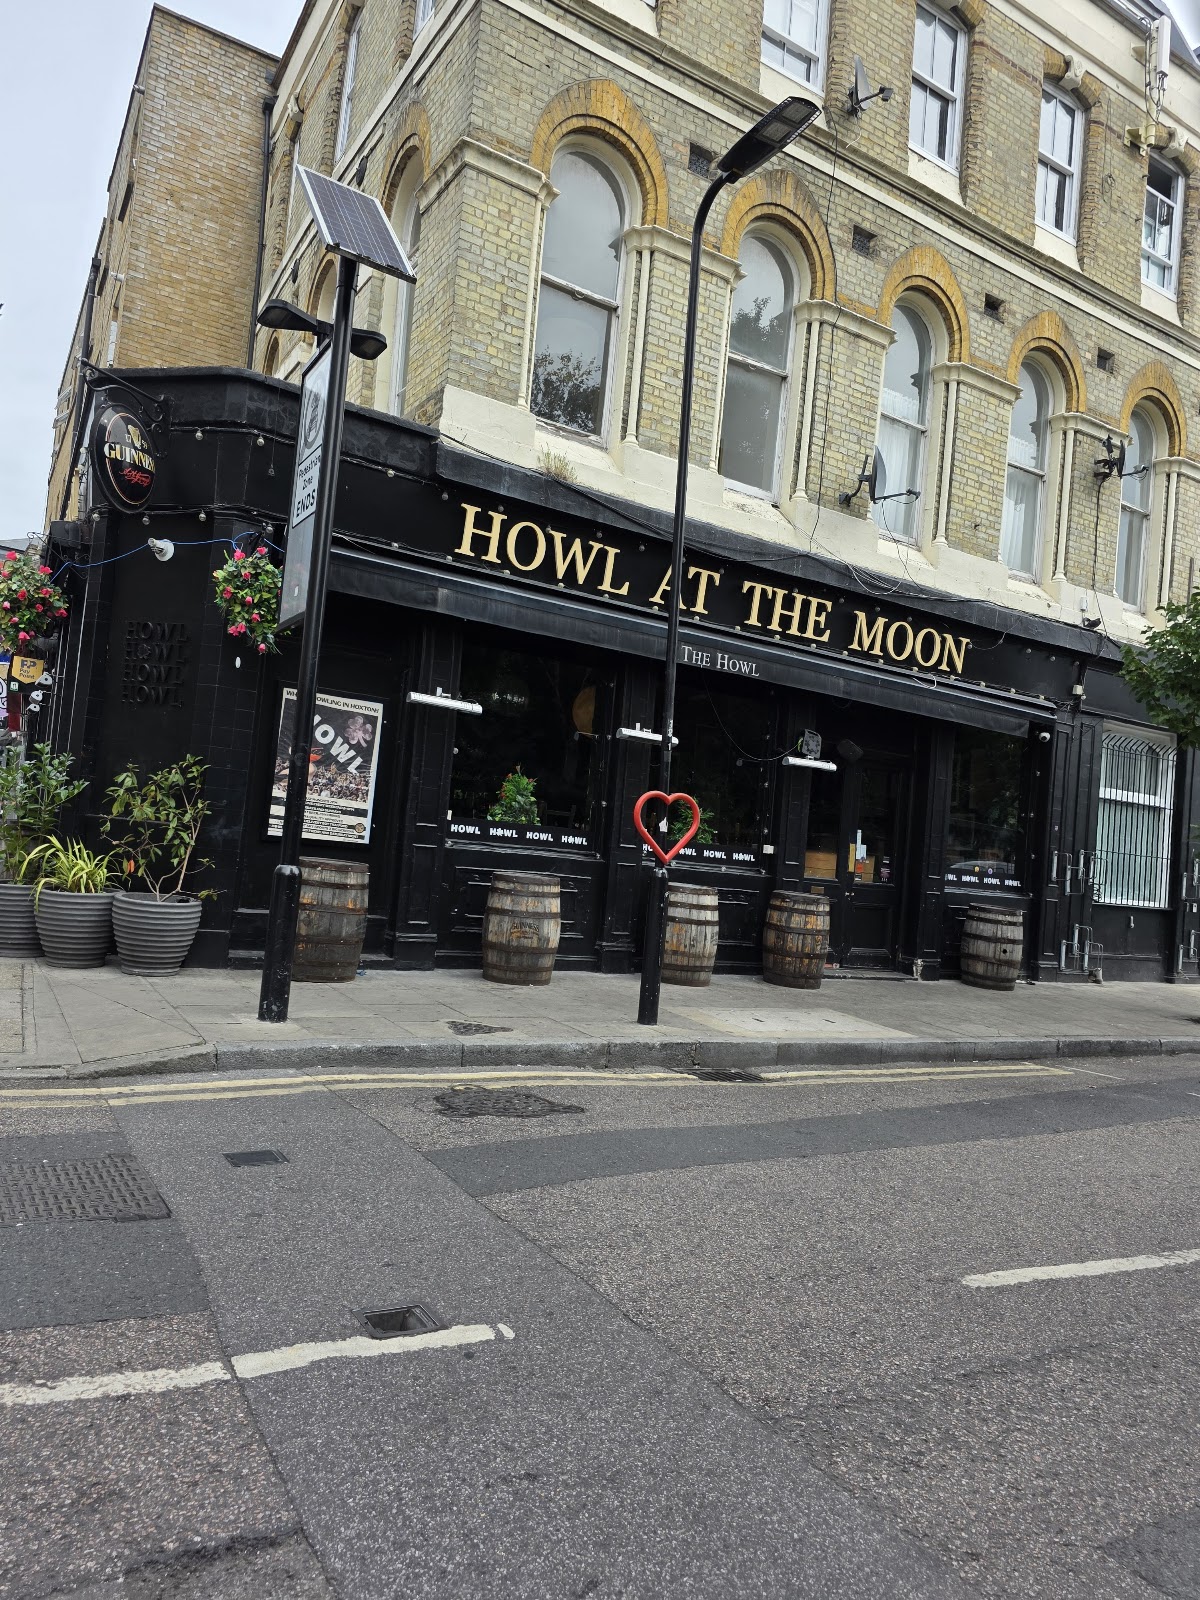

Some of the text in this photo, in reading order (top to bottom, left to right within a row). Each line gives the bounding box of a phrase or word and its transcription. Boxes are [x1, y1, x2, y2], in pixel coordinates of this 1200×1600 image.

[296, 489, 316, 518] ENDS
[454, 503, 970, 674] HOWL AT THE MOON
[19, 672, 35, 680] Point
[316, 696, 342, 707] OWLING
[314, 714, 363, 777] OWL
[450, 823, 481, 835] HOWL
[526, 831, 554, 842] HOWL
[703, 849, 727, 859] HOWL
